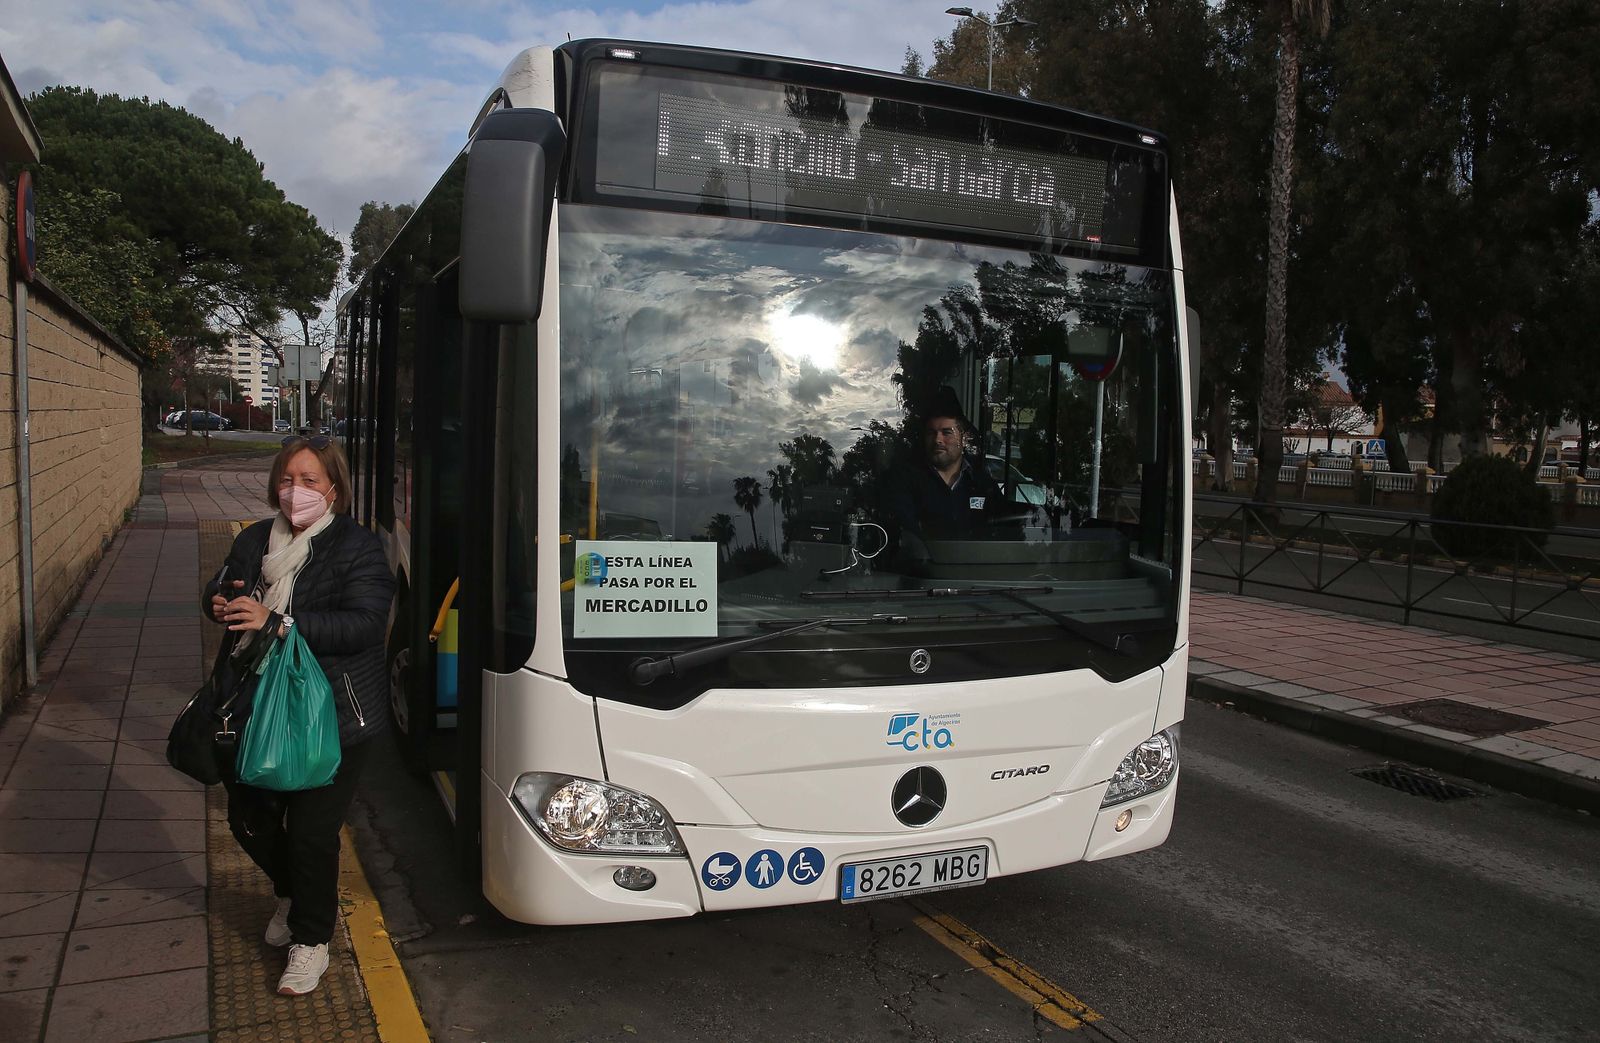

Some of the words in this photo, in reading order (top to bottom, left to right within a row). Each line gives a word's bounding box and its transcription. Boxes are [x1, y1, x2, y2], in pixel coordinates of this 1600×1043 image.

[605, 556, 644, 568] ESTA
[648, 554, 693, 568] LÍNEA
[599, 577, 640, 588] PASA
[644, 577, 675, 588] POR
[679, 577, 697, 588] EL
[585, 599, 708, 613] MERCADILLO
[902, 718, 955, 751] cta
[990, 764, 1050, 780] CITARO
[859, 861, 923, 893] 8262
[933, 853, 981, 883] MBG
[845, 886, 852, 894] E
